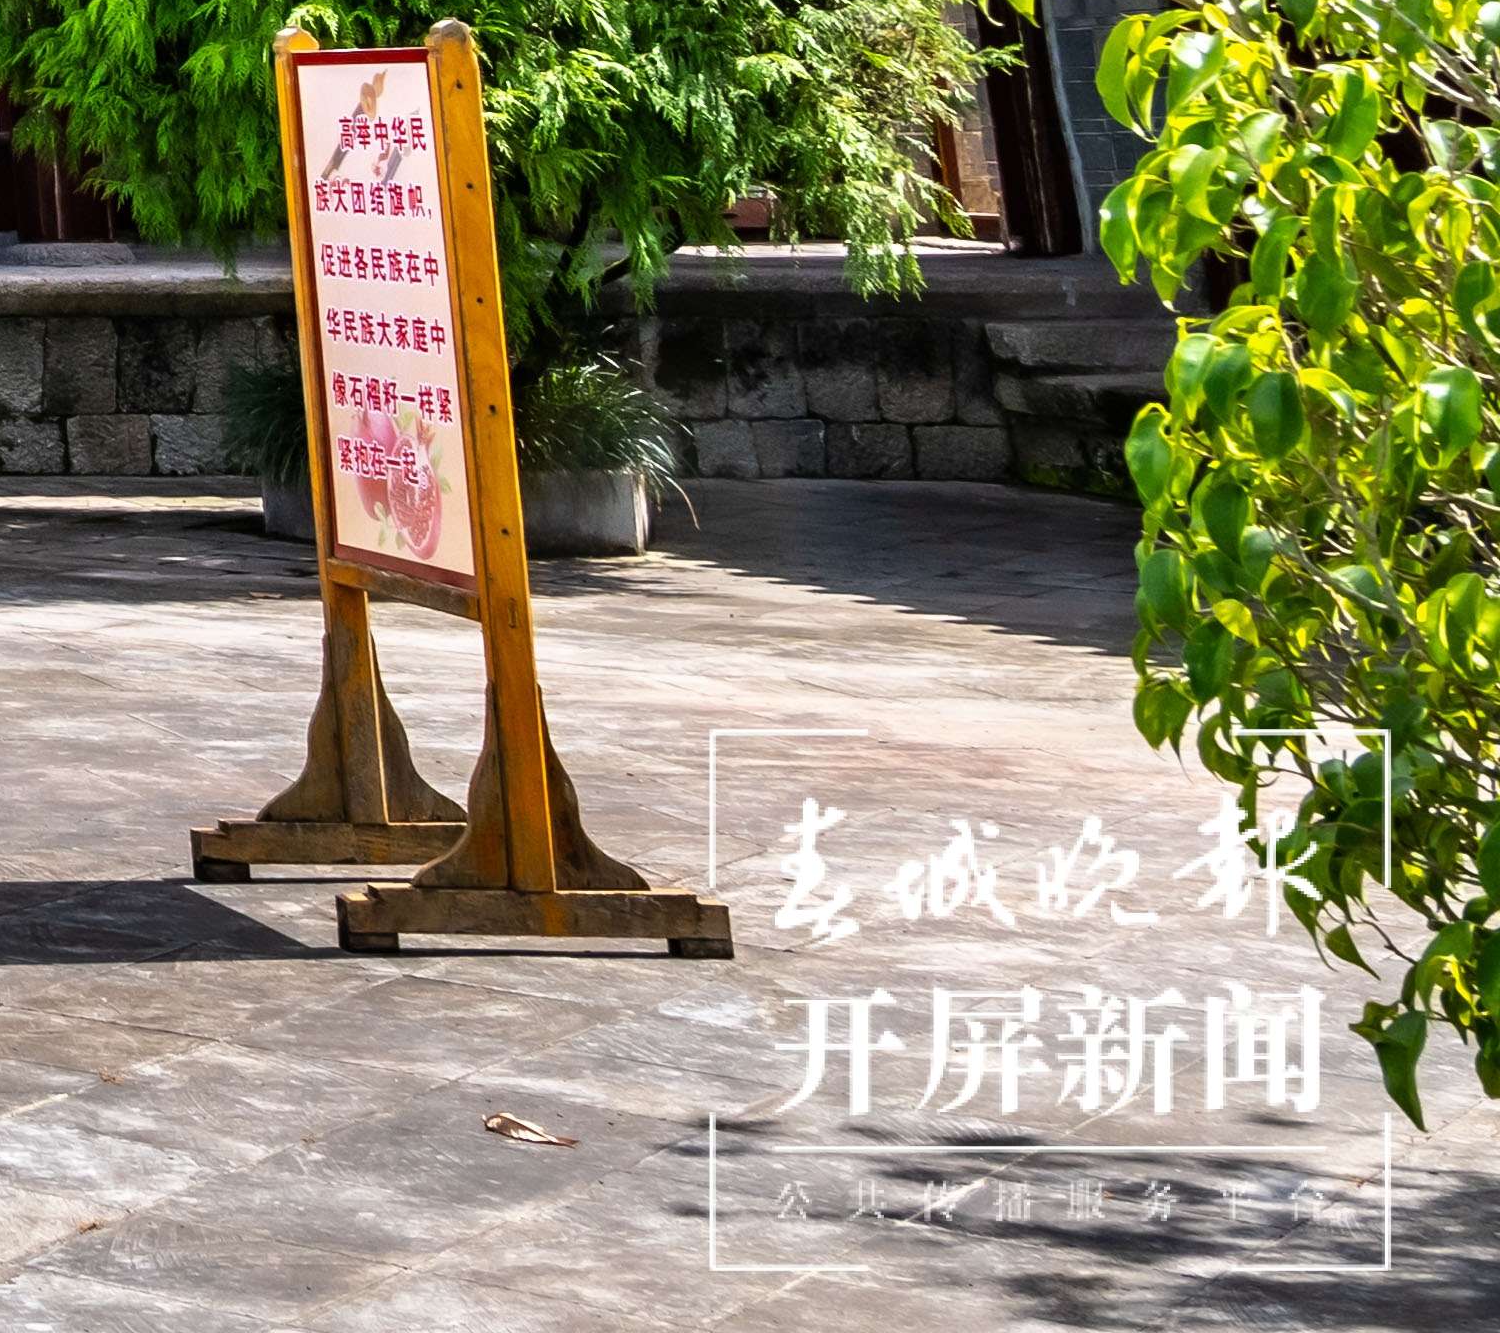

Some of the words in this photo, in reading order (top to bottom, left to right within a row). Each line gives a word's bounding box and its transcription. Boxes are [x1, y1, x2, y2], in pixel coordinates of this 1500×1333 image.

[338, 115, 427, 152] 高举中华民
[321, 243, 440, 287] 促进各民族在中
[326, 306, 447, 356] 华民族大家庭中
[332, 371, 454, 424] 像石榴籽一样紧
[337, 436, 429, 489] 紧抱在一起。
